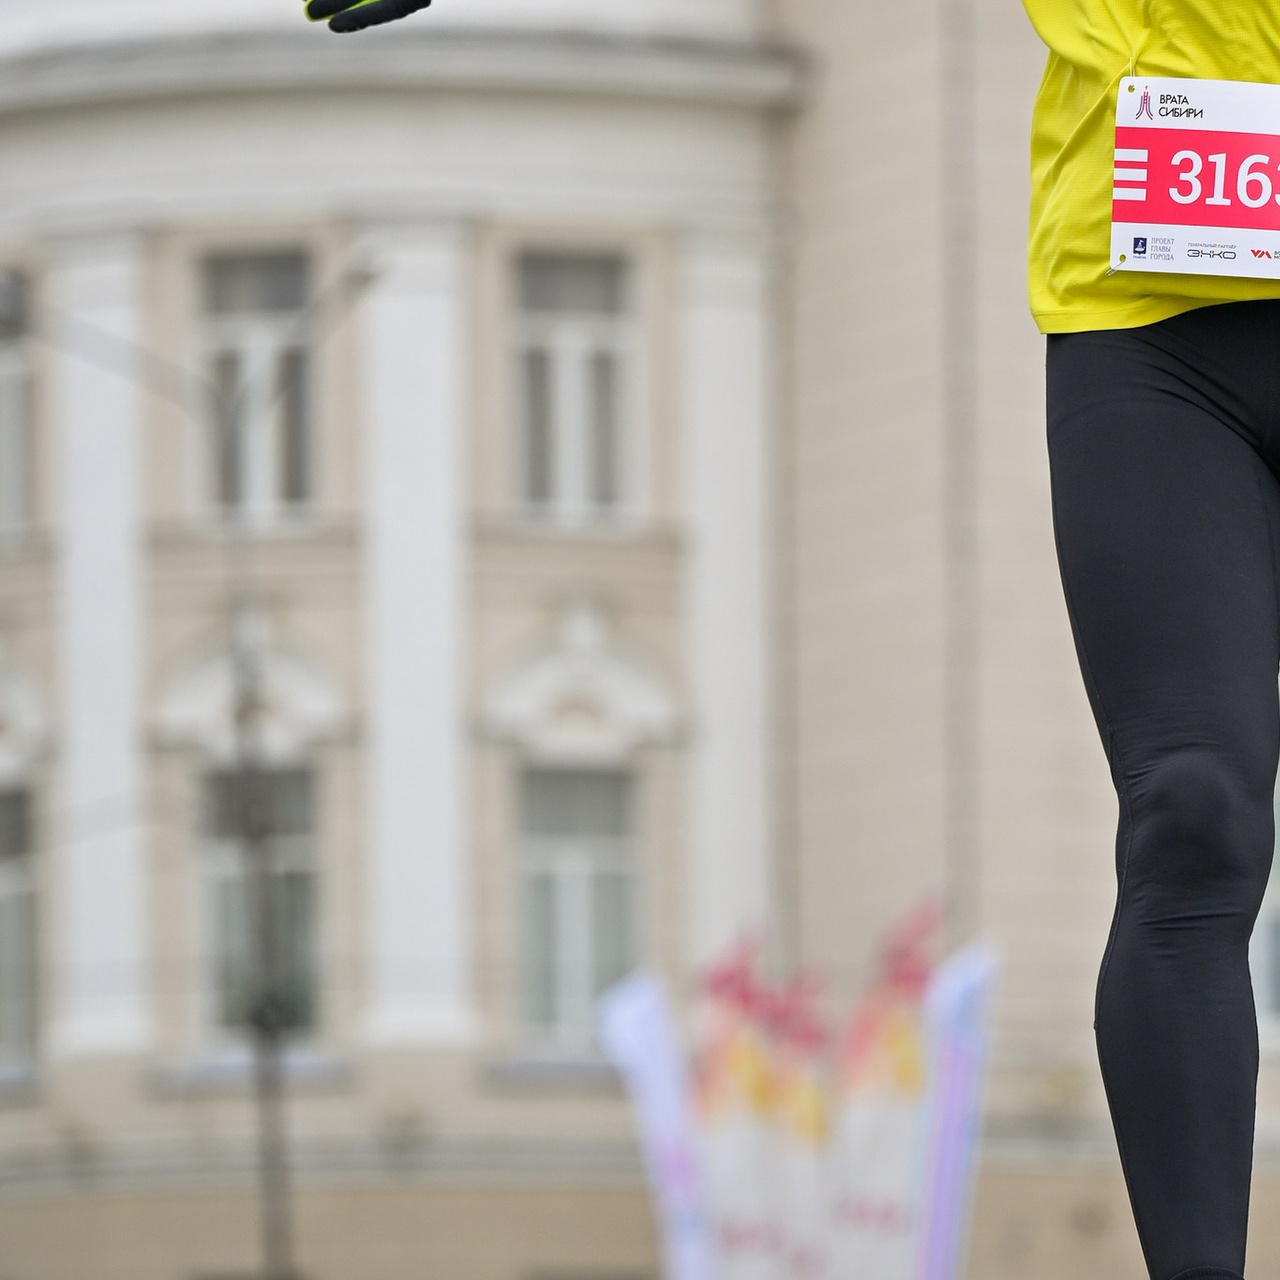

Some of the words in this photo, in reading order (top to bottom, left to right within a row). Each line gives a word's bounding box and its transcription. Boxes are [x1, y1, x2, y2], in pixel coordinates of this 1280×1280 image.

[1159, 94, 1189, 105] ВРАТА
[1158, 107, 1204, 118] СИБИРИ
[1151, 237, 1174, 245] ПРОЕКТ
